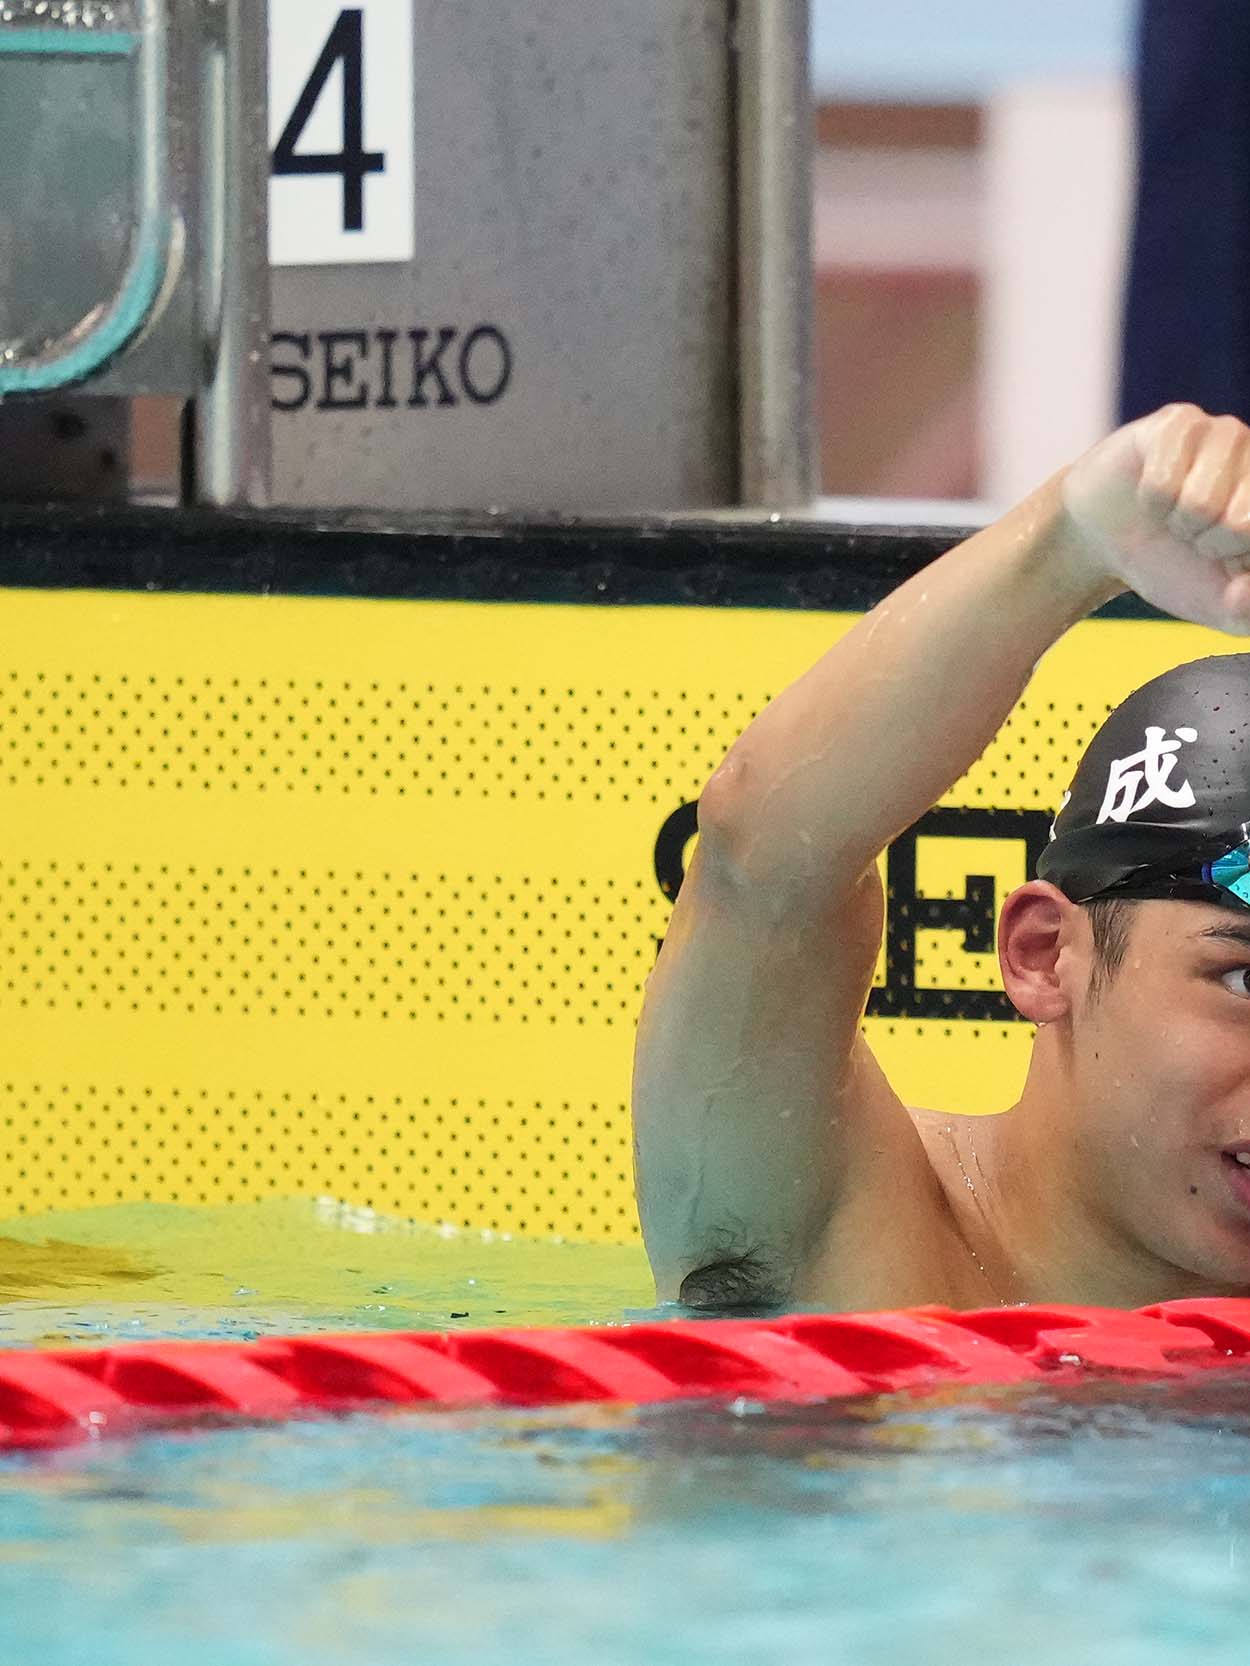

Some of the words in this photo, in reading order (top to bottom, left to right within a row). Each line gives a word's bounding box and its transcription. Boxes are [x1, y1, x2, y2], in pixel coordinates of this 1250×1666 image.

[272, 9, 385, 232] 4
[271, 325, 512, 411] SEIKO
[1096, 726, 1198, 825] 成
